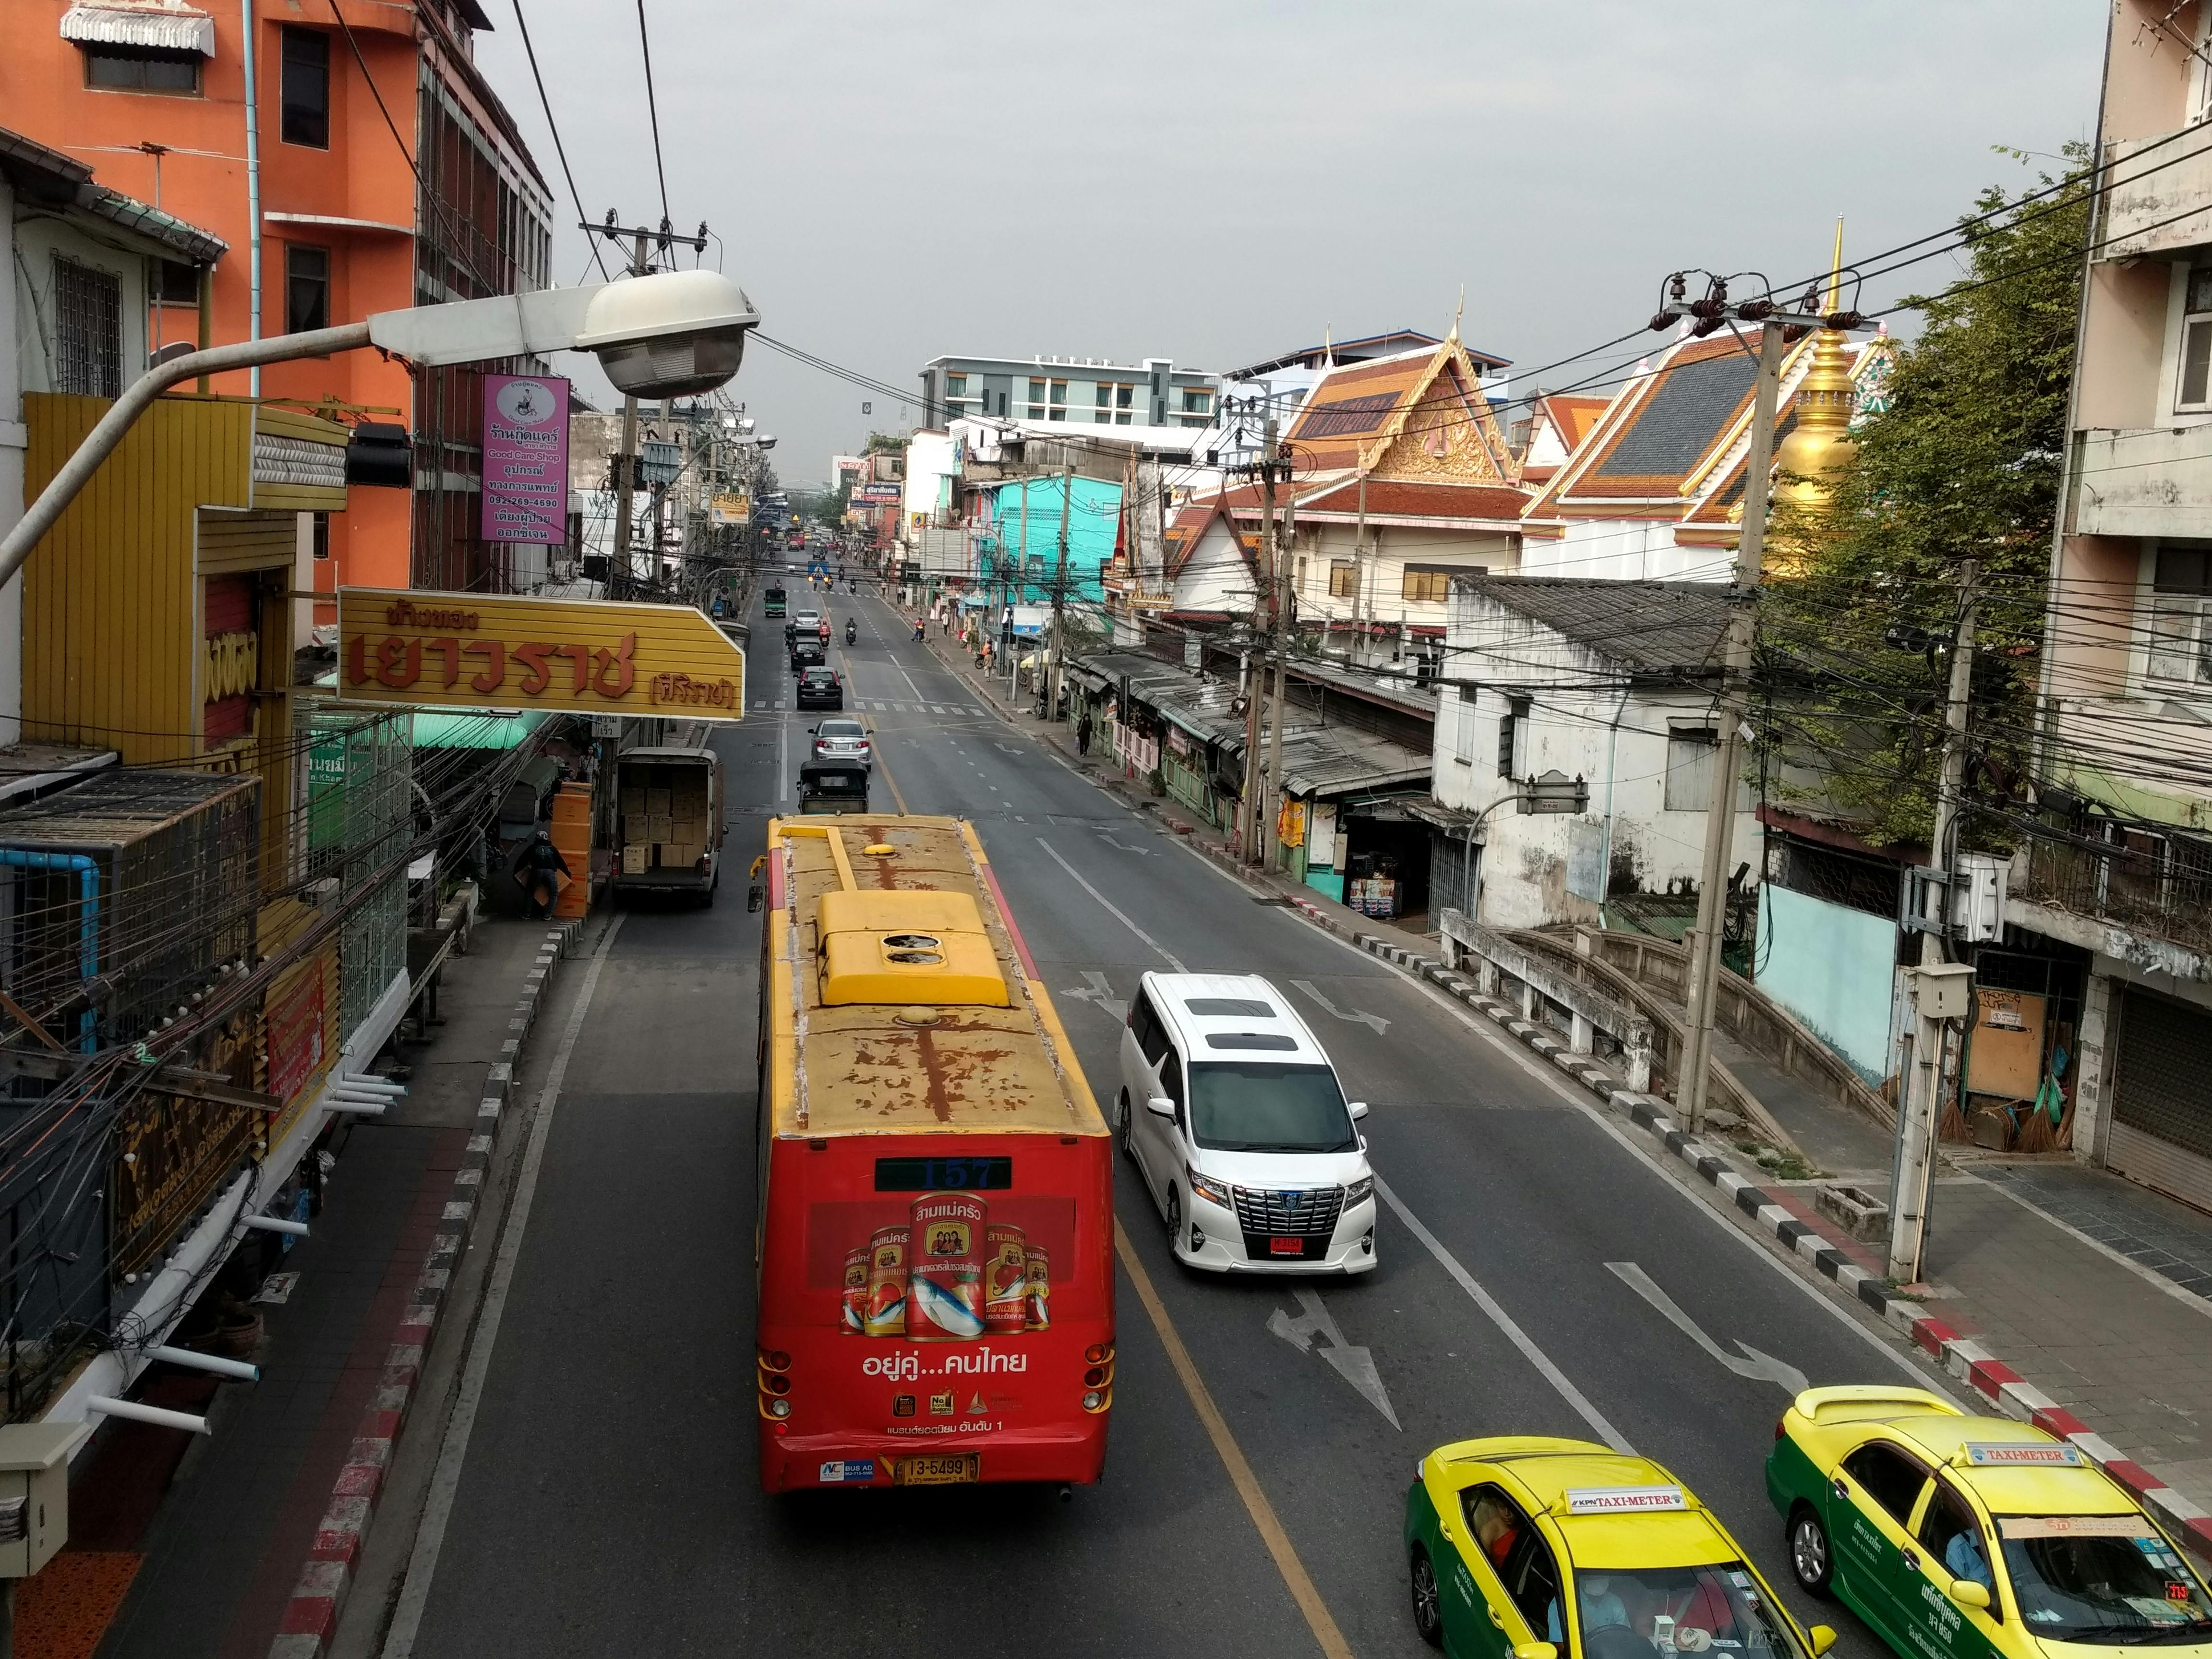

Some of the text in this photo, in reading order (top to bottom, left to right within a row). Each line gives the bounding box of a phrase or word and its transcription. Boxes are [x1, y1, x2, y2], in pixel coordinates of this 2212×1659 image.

[491, 424, 557, 445] ร้านกู๊ดแคร์
[489, 450, 560, 463] Good Care Shop
[504, 464, 544, 478] อุปกรณ์
[489, 481, 558, 493] ทางการแพทย์
[489, 496, 557, 507] 092-269-4690
[712, 493, 748, 504] ขายยา
[495, 510, 551, 526] เตียงผู้ป่วย
[387, 599, 479, 629] ห้างทอง
[349, 632, 636, 698] เยาวราช
[650, 673, 734, 709] (ศิริราช)
[600, 725, 613, 735] เร็ว
[922, 1159, 991, 1189] 157
[916, 1201, 981, 1221] สามแม่ครัว
[863, 1346, 1027, 1381] อยู่คู่...คนไทย
[959, 1420, 992, 1432] อันดับ
[997, 1421, 1003, 1431] 1
[1986, 1449, 2065, 1462] TAXI-METER
[910, 1459, 963, 1476] 13-5499
[1597, 1495, 1672, 1507] TAXI-METER
[1922, 1584, 1961, 1632] แท็กซี่บุคคล
